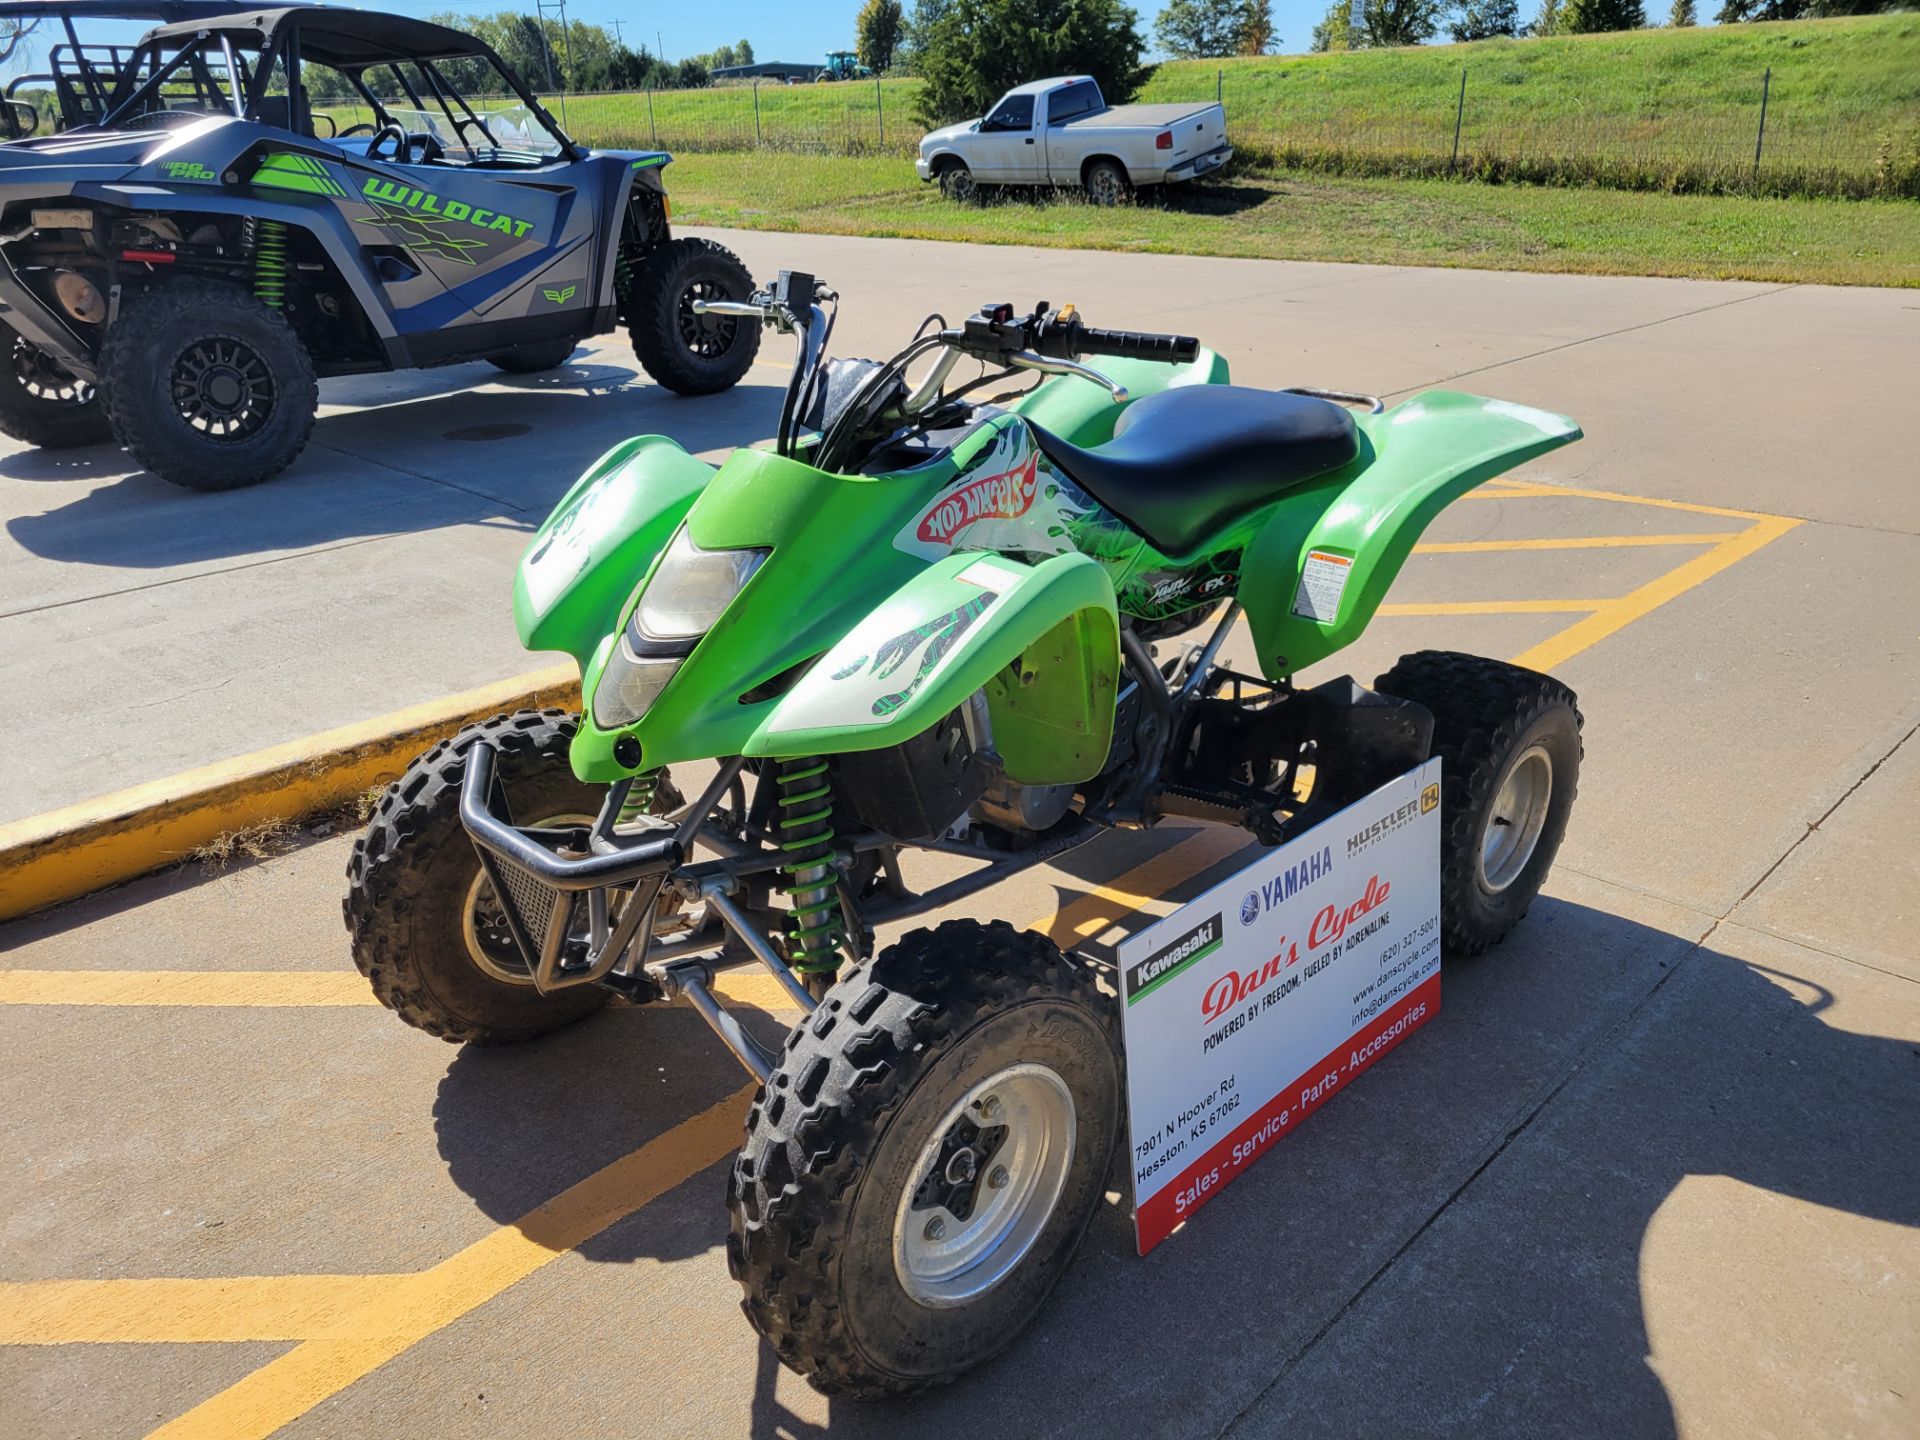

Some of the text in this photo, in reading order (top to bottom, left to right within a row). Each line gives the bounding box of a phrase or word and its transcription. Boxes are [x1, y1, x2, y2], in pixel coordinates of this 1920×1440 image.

[170, 170, 216, 180] PRO
[362, 177, 536, 239] WILDCAT
[1346, 799, 1418, 852] HUSTLER
[1347, 843, 1368, 860] TURF
[1371, 813, 1418, 846] EQUIPMENT
[1261, 846, 1333, 912] YAMAHA
[1137, 922, 1213, 987] Kawasaki
[1201, 874, 1391, 1025] Dan's Cycle
[1352, 936, 1439, 1005] www.danscycle.com
[1379, 915, 1439, 968] (620) 327-5001
[1203, 911, 1391, 1055] POWERED BY FREEDOM, FUELED BY ADRENALINE
[1351, 956, 1439, 1027] info@danscycle.com
[1135, 1073, 1235, 1161] 7901 N Hoover Rd
[1137, 1093, 1241, 1185] Hesston, KS 67062
[1175, 1166, 1219, 1214] Sales
[1232, 1110, 1289, 1166] Service
[1301, 1068, 1338, 1110] Parts
[1349, 1001, 1426, 1072] Accessories
